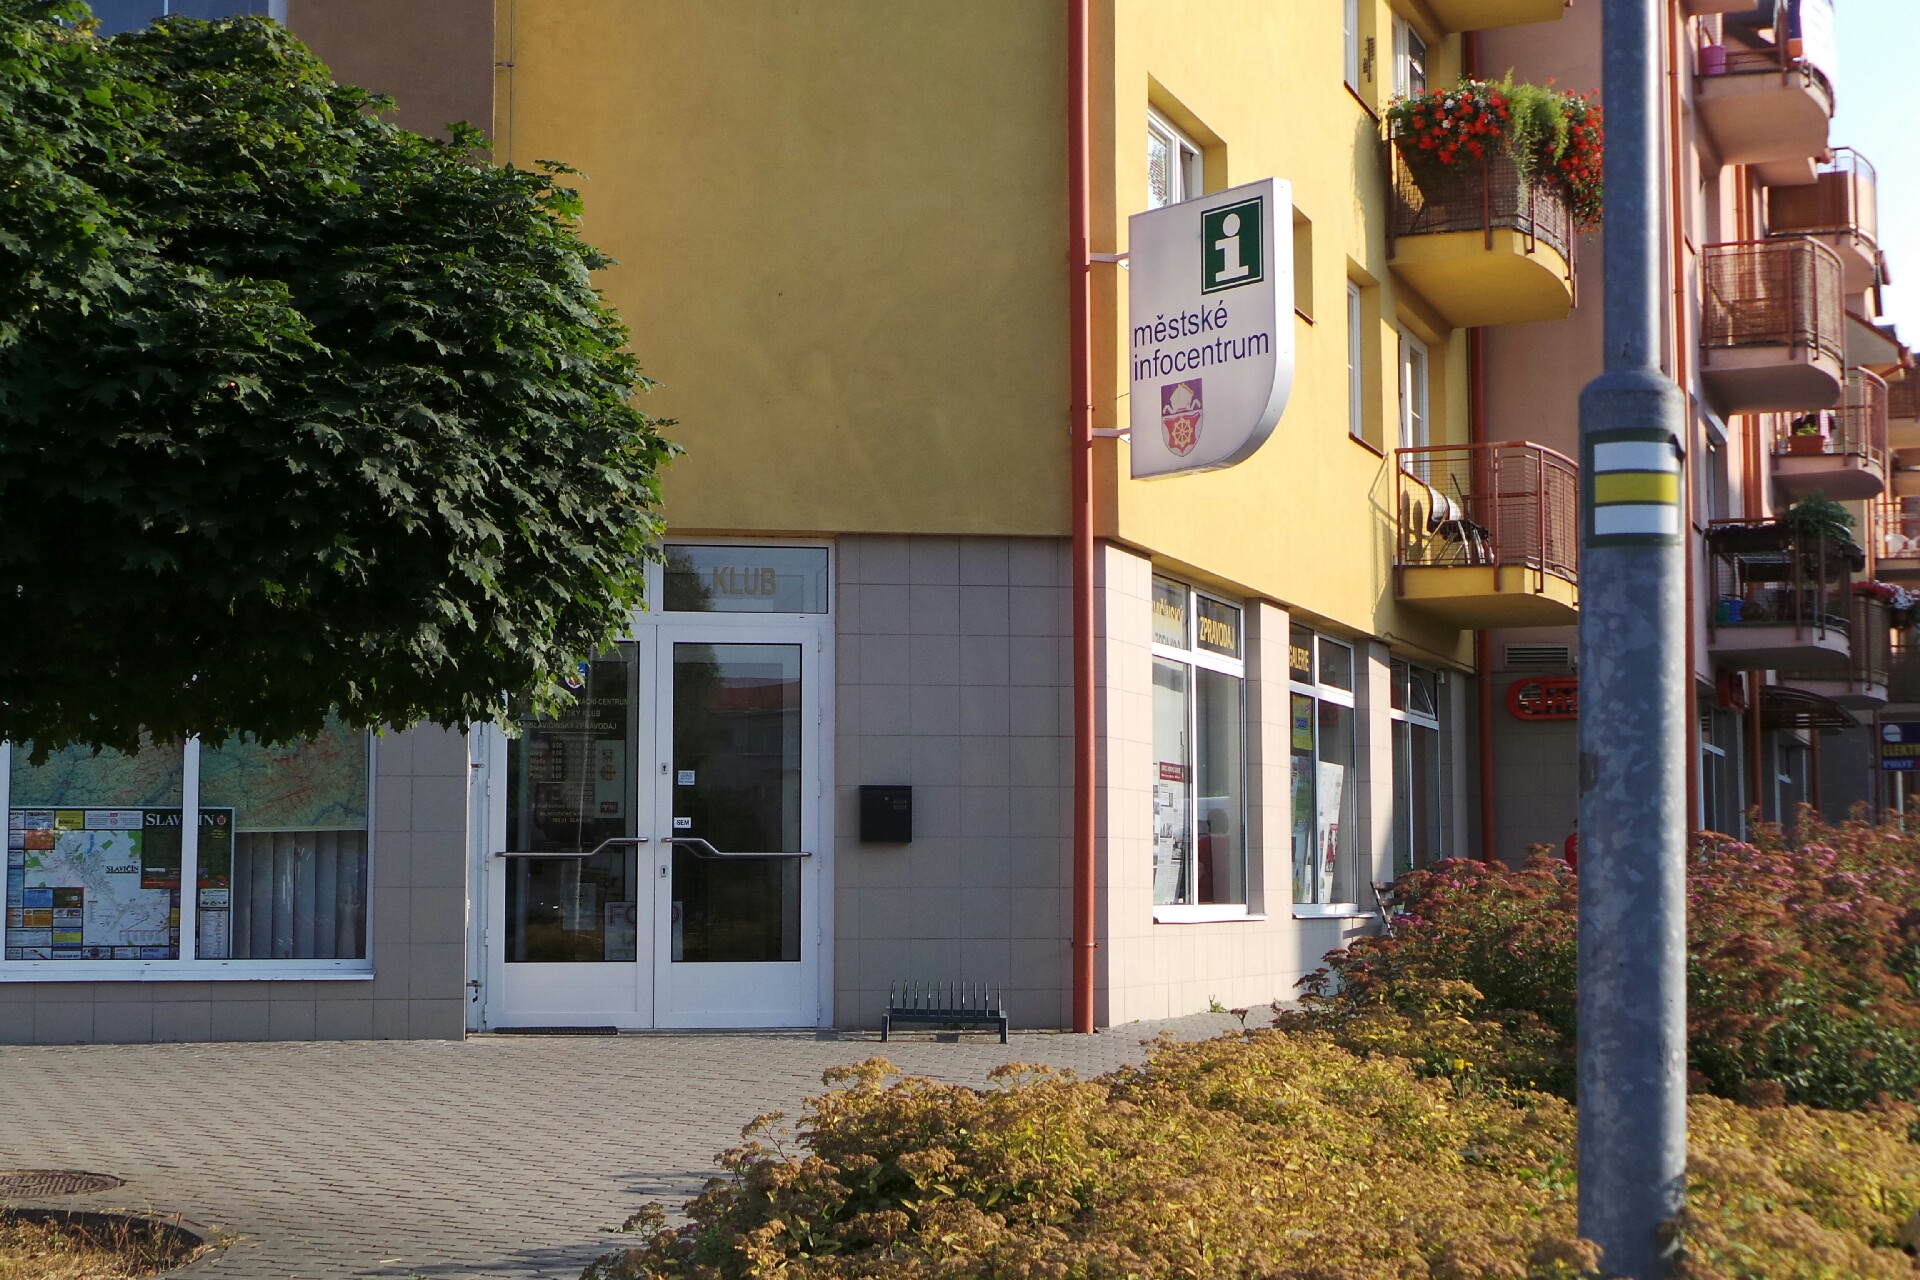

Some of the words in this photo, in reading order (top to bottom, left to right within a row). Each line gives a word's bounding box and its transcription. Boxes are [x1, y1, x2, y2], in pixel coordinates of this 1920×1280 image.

[1134, 300, 1228, 348] městské
[1134, 332, 1269, 381] infocentrum
[712, 566, 777, 596] KLUB
[145, 812, 215, 826] SLAVÍN
[106, 864, 139, 873] SLAVIČÍN
